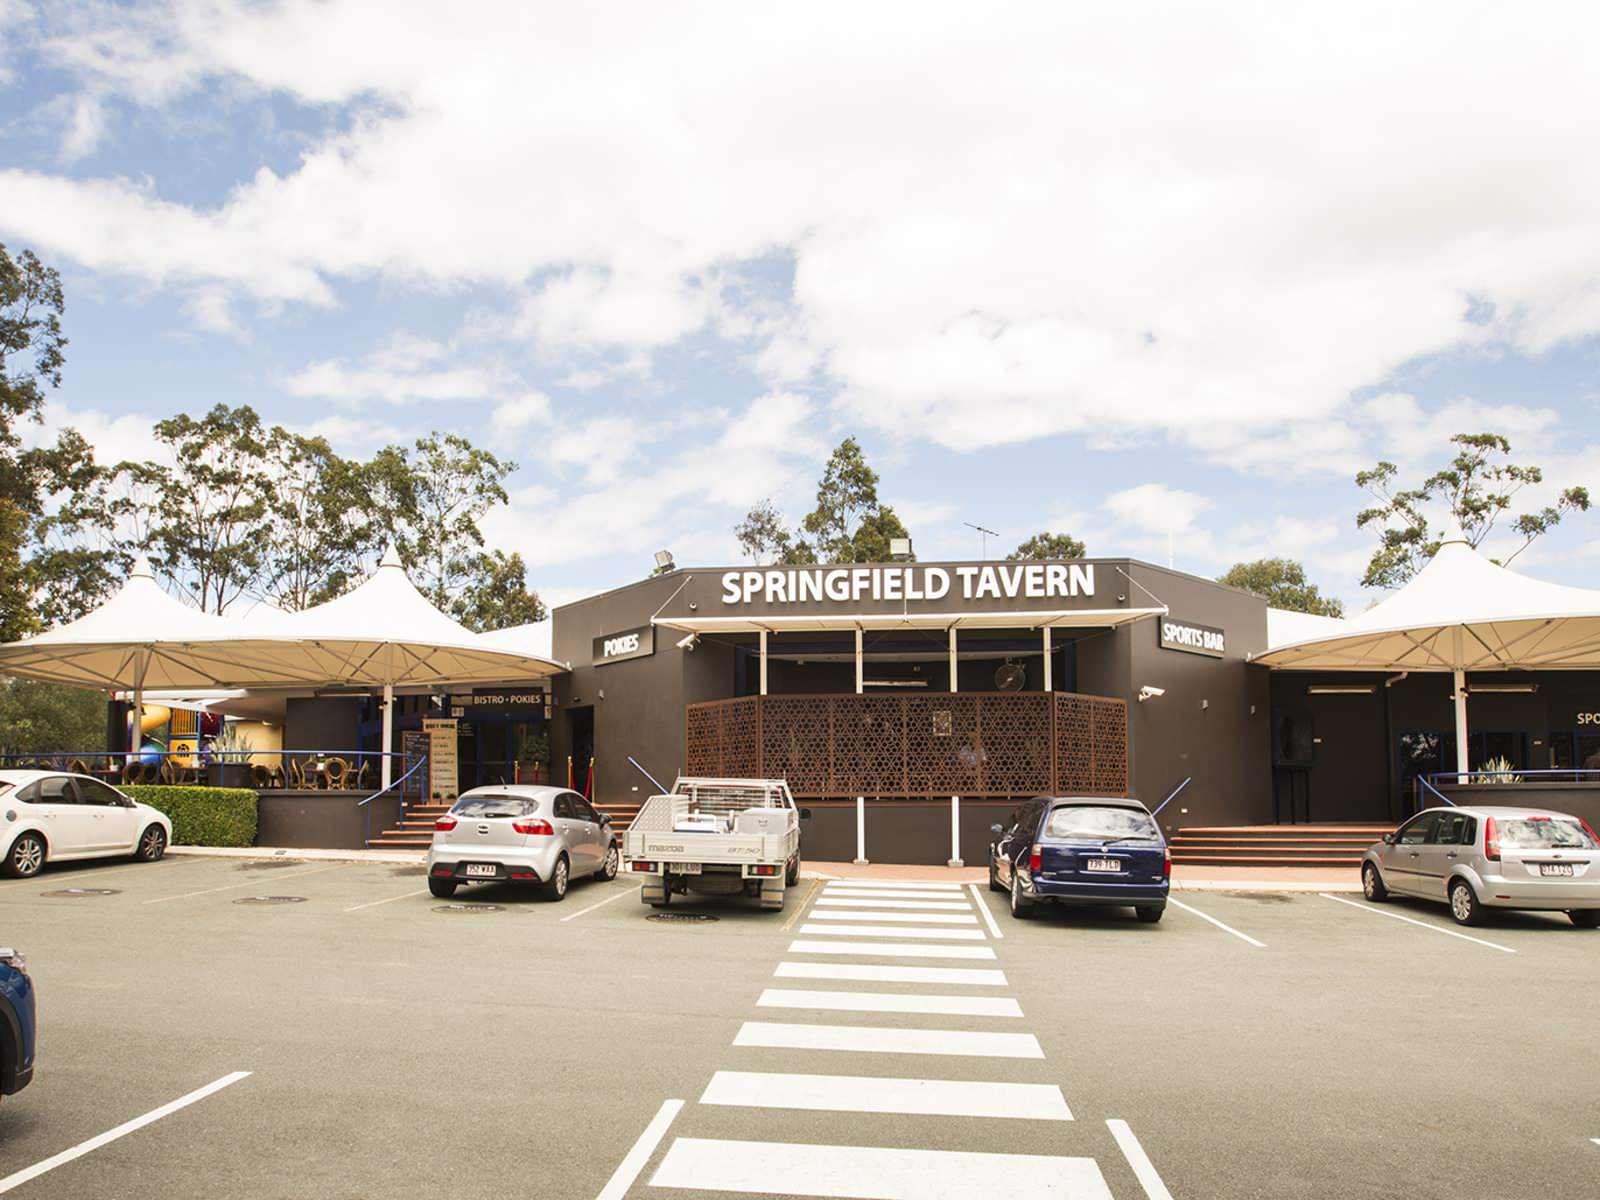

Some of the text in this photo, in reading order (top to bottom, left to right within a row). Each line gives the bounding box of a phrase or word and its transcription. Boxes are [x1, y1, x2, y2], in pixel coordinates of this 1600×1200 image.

[721, 564, 1095, 604] SPRINGFIELD TAVERN
[603, 633, 640, 658] POKIES
[1163, 622, 1225, 652] SPORTS BAR
[473, 694, 542, 705] BISTRO POKIES
